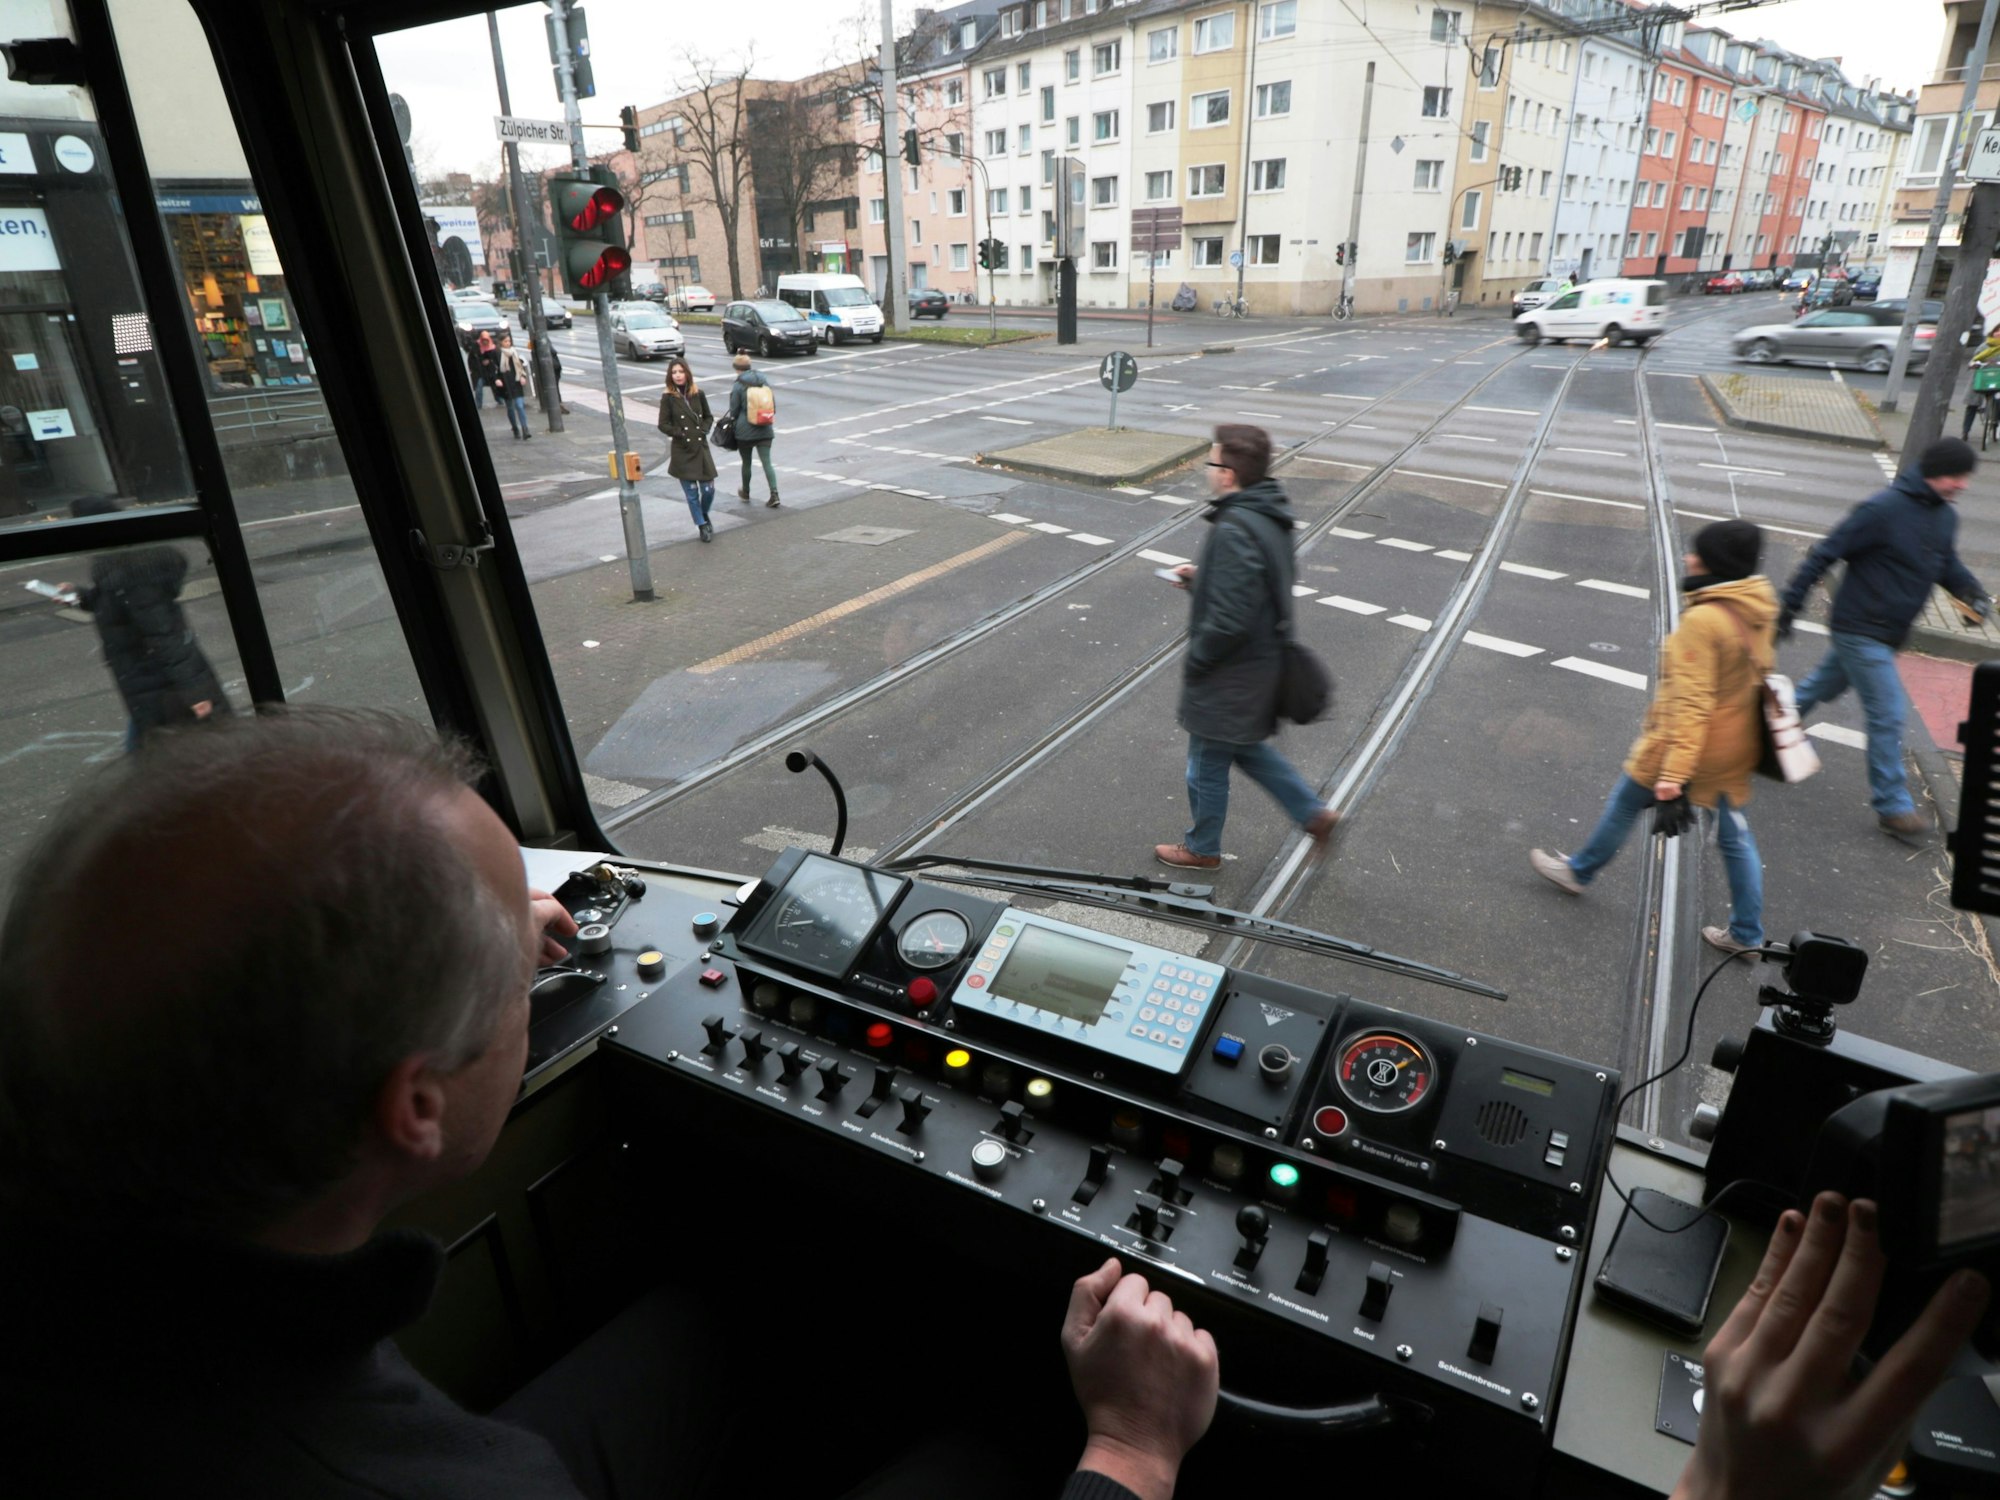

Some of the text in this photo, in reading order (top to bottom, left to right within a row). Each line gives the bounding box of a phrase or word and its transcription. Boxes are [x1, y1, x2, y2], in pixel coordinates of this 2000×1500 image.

[500, 119, 567, 141] Zülpicher Str.
[1222, 1031, 1246, 1045] SENDEN
[755, 1085, 787, 1102] Beleuchtung
[801, 1104, 823, 1116] Spiegel
[841, 1120, 863, 1133] Spiegel
[1062, 1209, 1081, 1222] Vorne
[1100, 1234, 1119, 1247] Türen
[1132, 1241, 1147, 1251] Auf
[1211, 1269, 1260, 1295] Lautsprecher
[1268, 1293, 1329, 1323] Fahrerraumlicht
[1353, 1327, 1375, 1341] Sand
[1438, 1360, 1511, 1396] Schienenbremse
